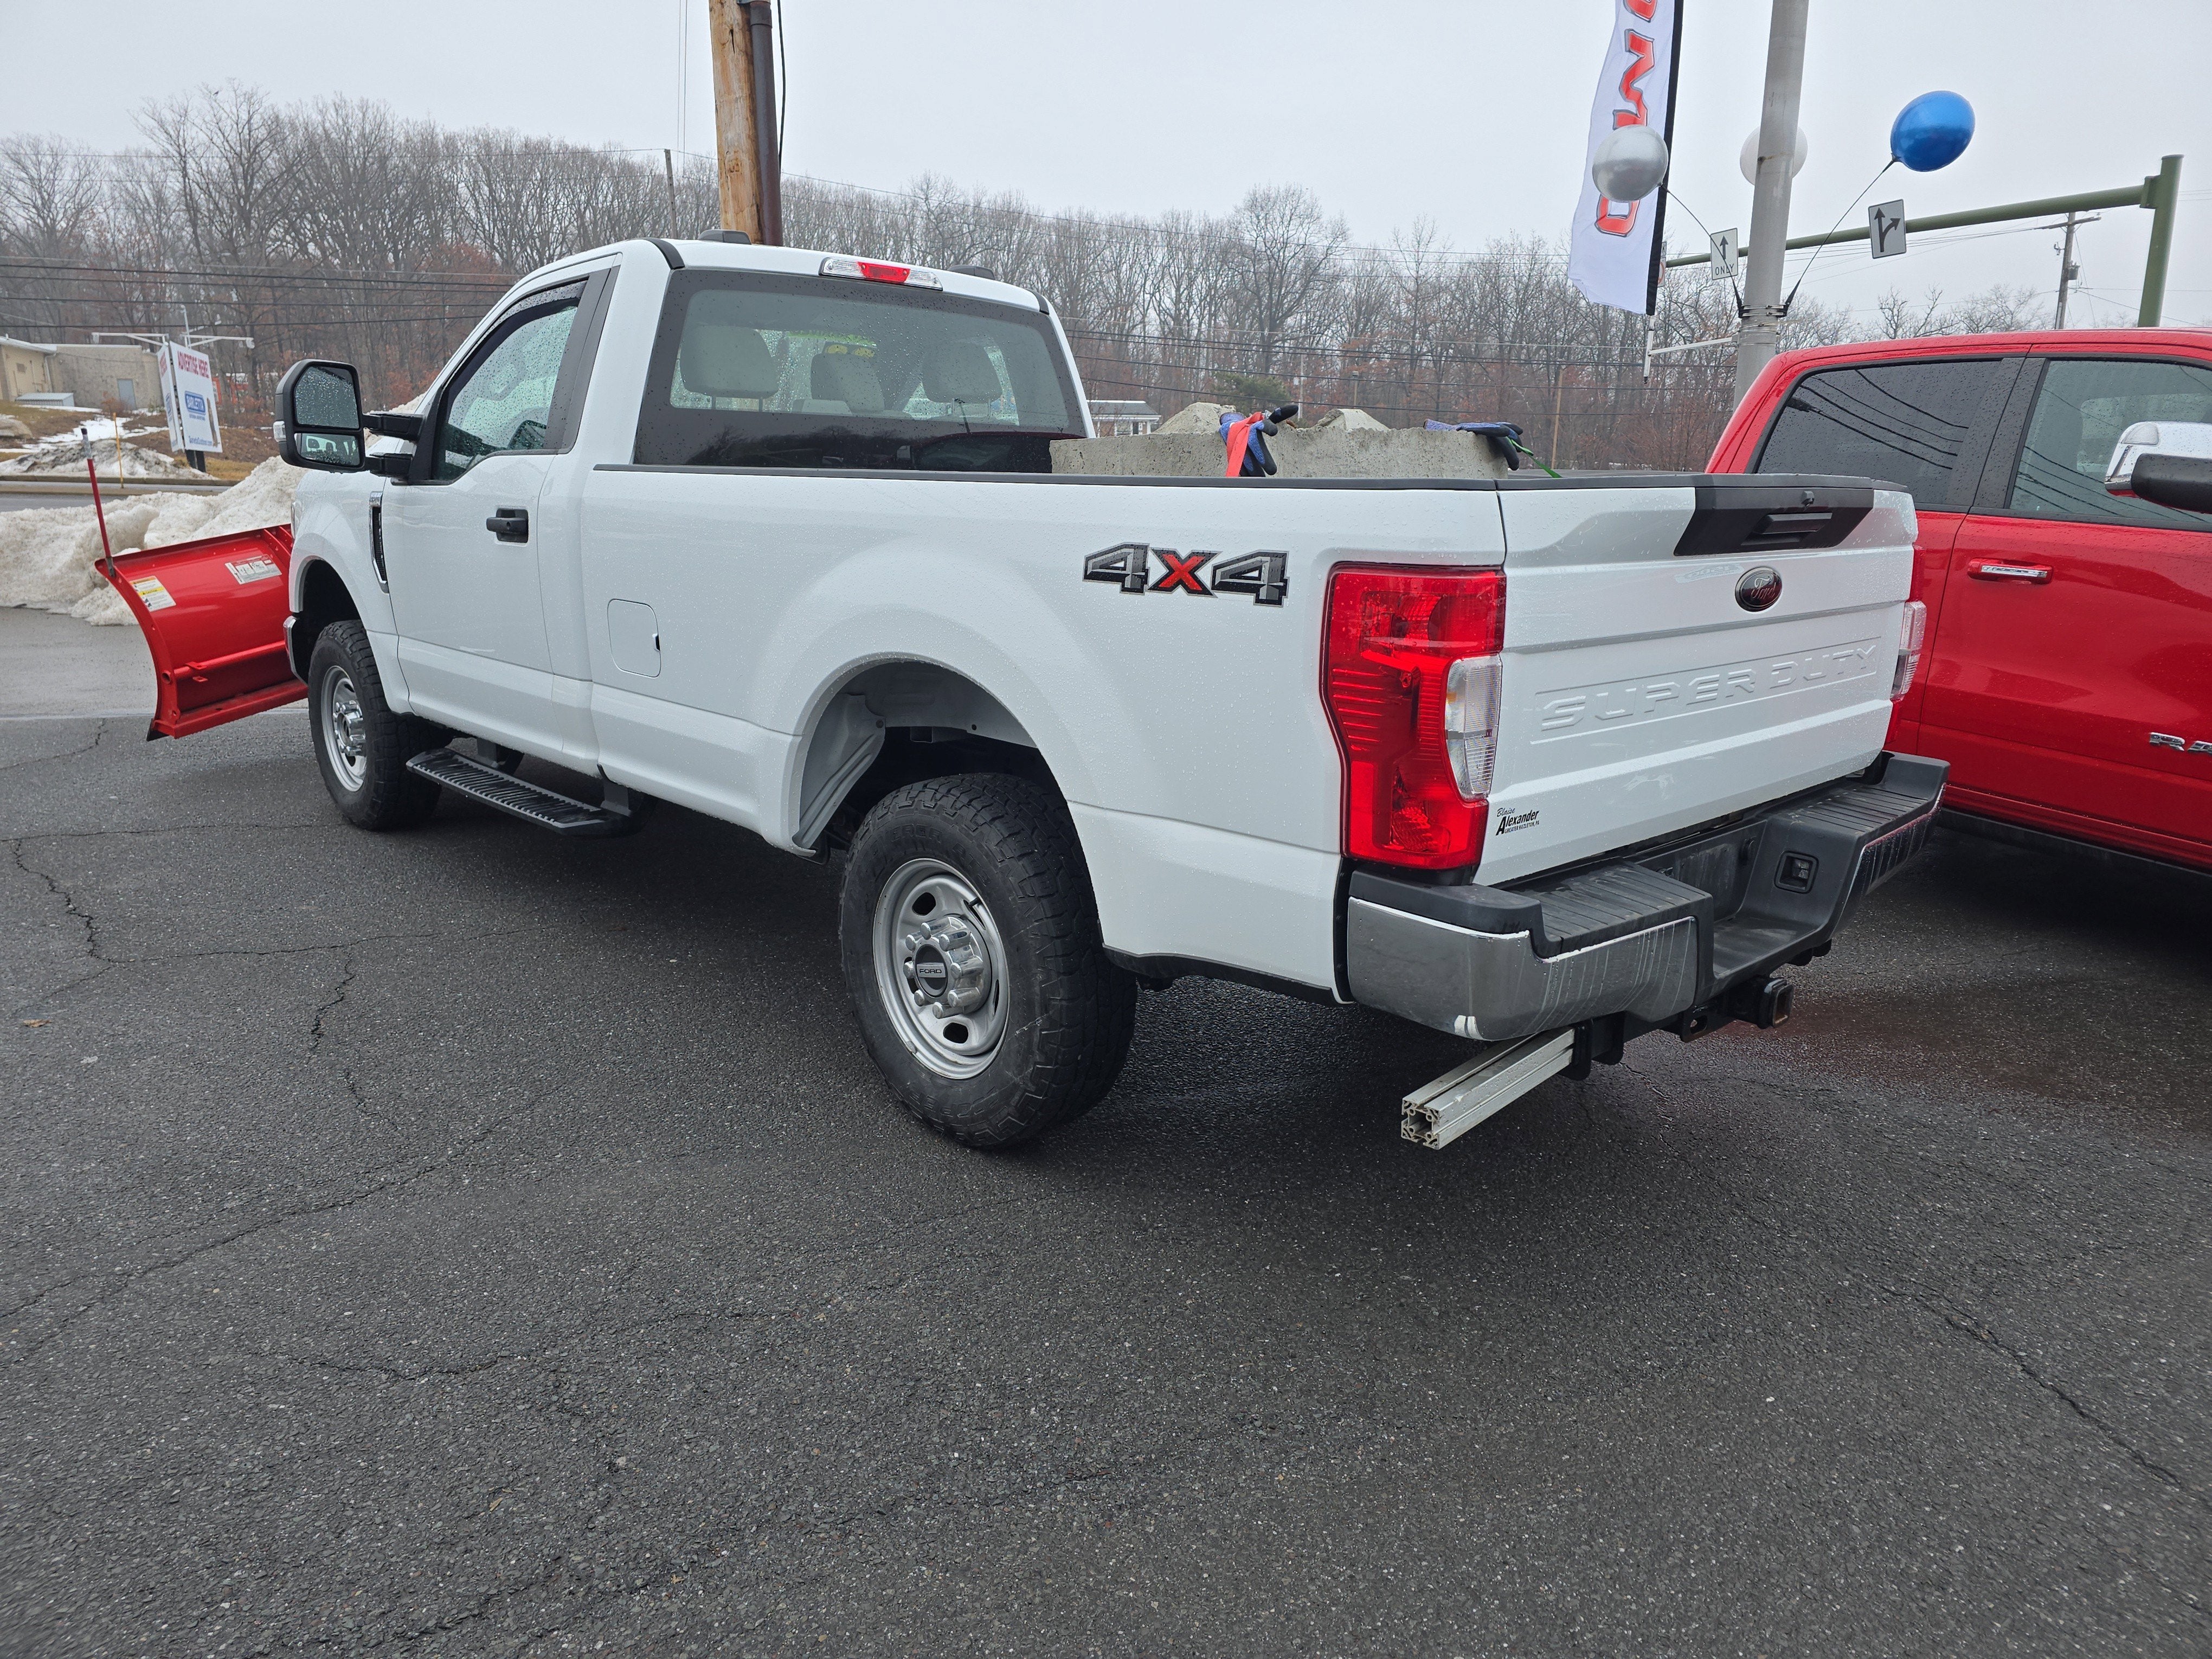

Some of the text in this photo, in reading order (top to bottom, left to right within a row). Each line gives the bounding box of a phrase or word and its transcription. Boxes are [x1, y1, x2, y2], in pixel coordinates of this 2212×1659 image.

[1715, 263, 1734, 275] ONLY
[1083, 542, 1290, 607] 4X4
[1751, 576, 1777, 600] Ford
[1541, 644, 1877, 732] SUPER DUTY
[1495, 809, 1540, 835] Alexander
[1496, 807, 1516, 817] Blaise
[1504, 825, 1519, 834] GREATER
